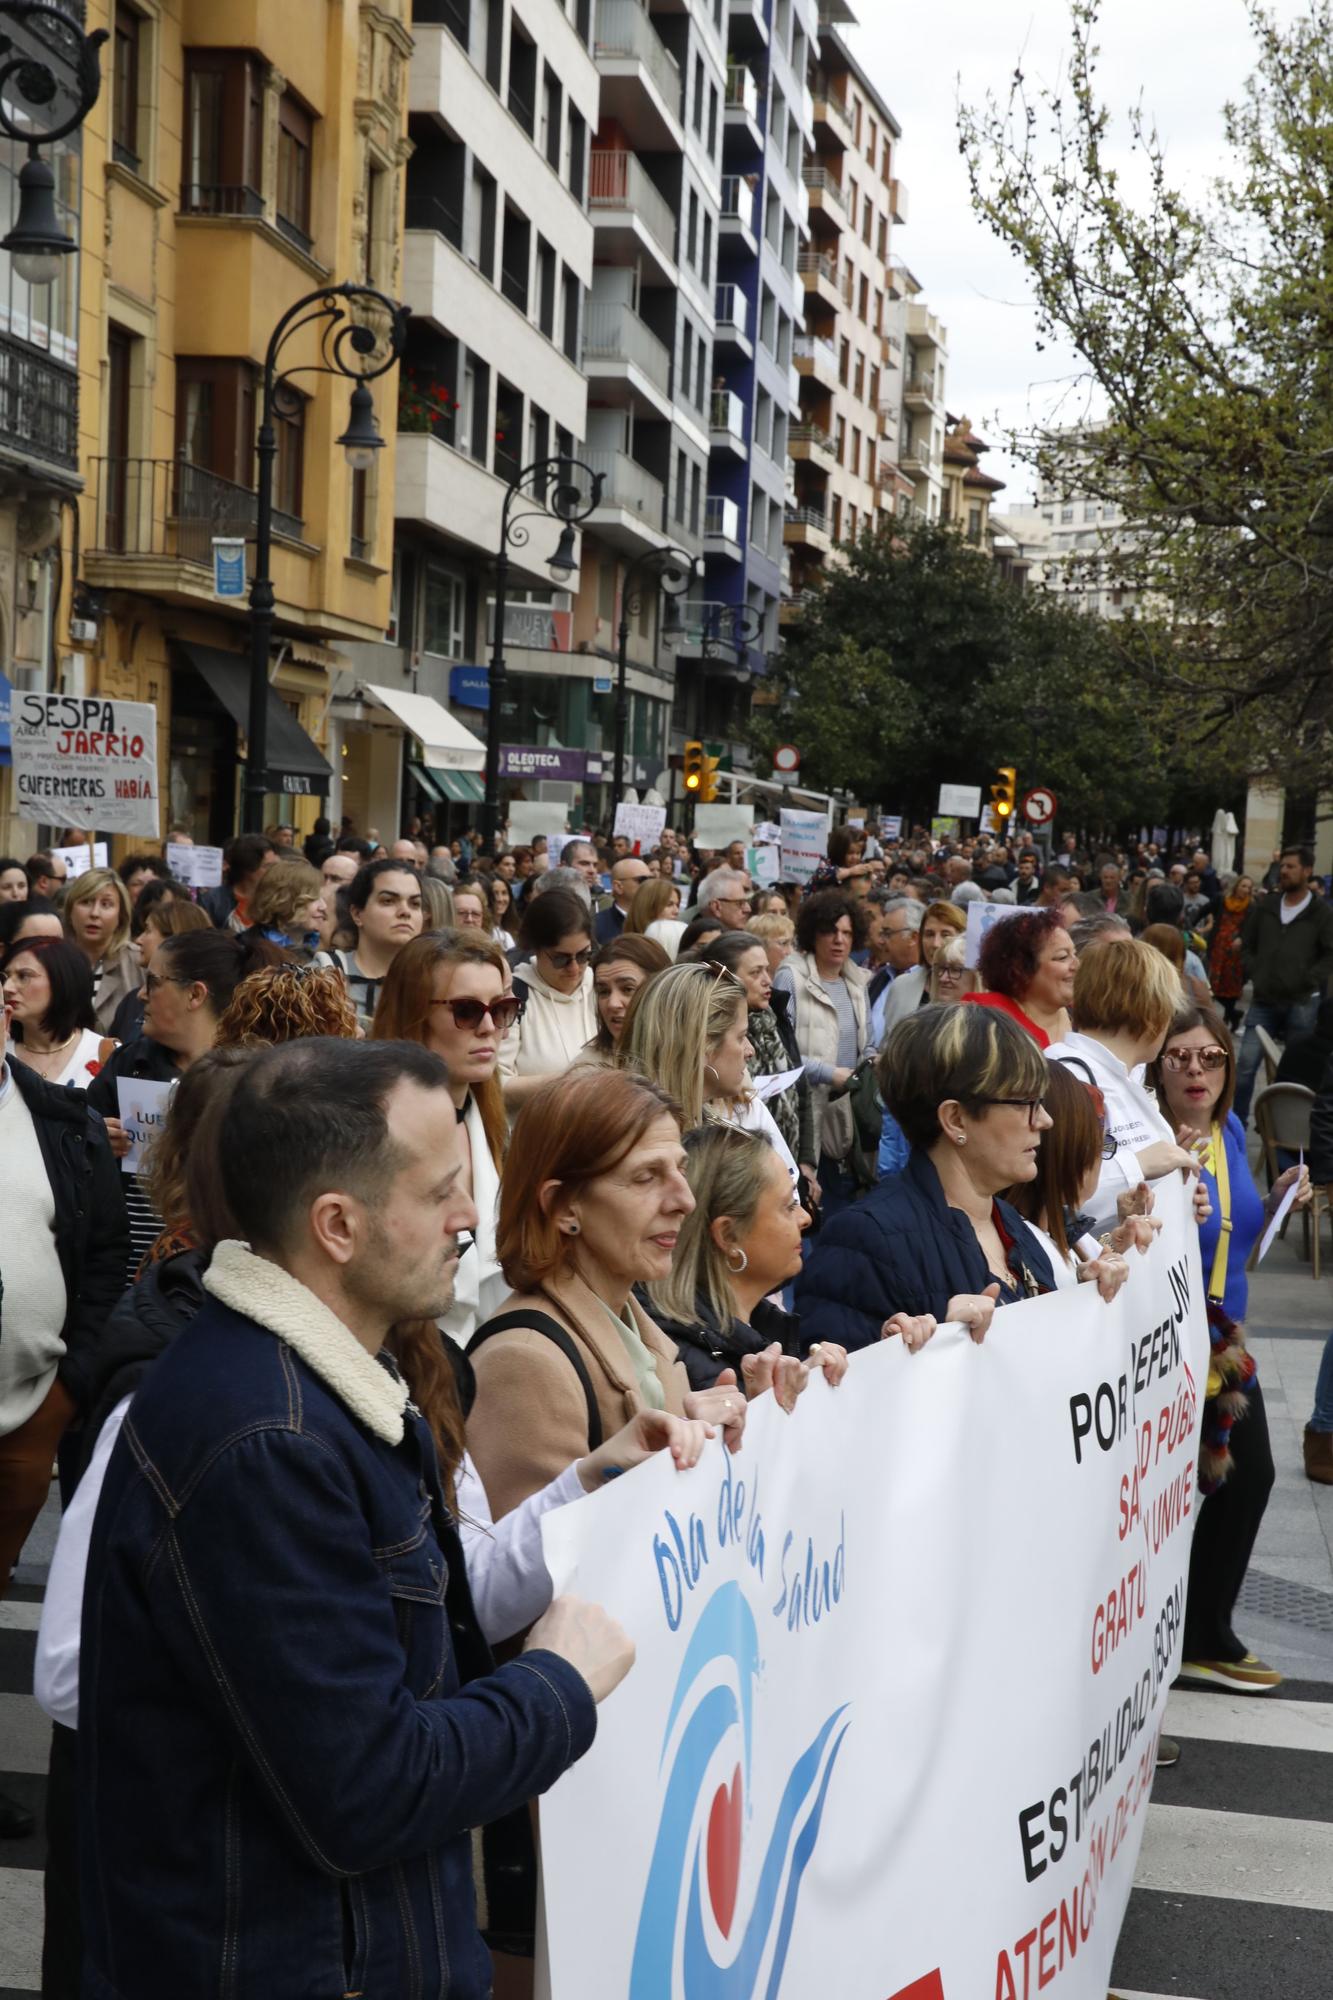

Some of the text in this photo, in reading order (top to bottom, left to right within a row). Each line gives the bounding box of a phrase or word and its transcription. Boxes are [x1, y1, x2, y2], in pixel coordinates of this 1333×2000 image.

[21, 695, 114, 732] SESPA
[18, 774, 105, 798] ENFERMERAS
[507, 752, 560, 767] OLEOTECA
[1070, 1373, 1127, 1465] POR
[718, 1440, 745, 1548] de
[746, 1462, 765, 1584] la
[772, 1507, 845, 1633] Salud
[1018, 1668, 1150, 1884] ESTABILIDAD
